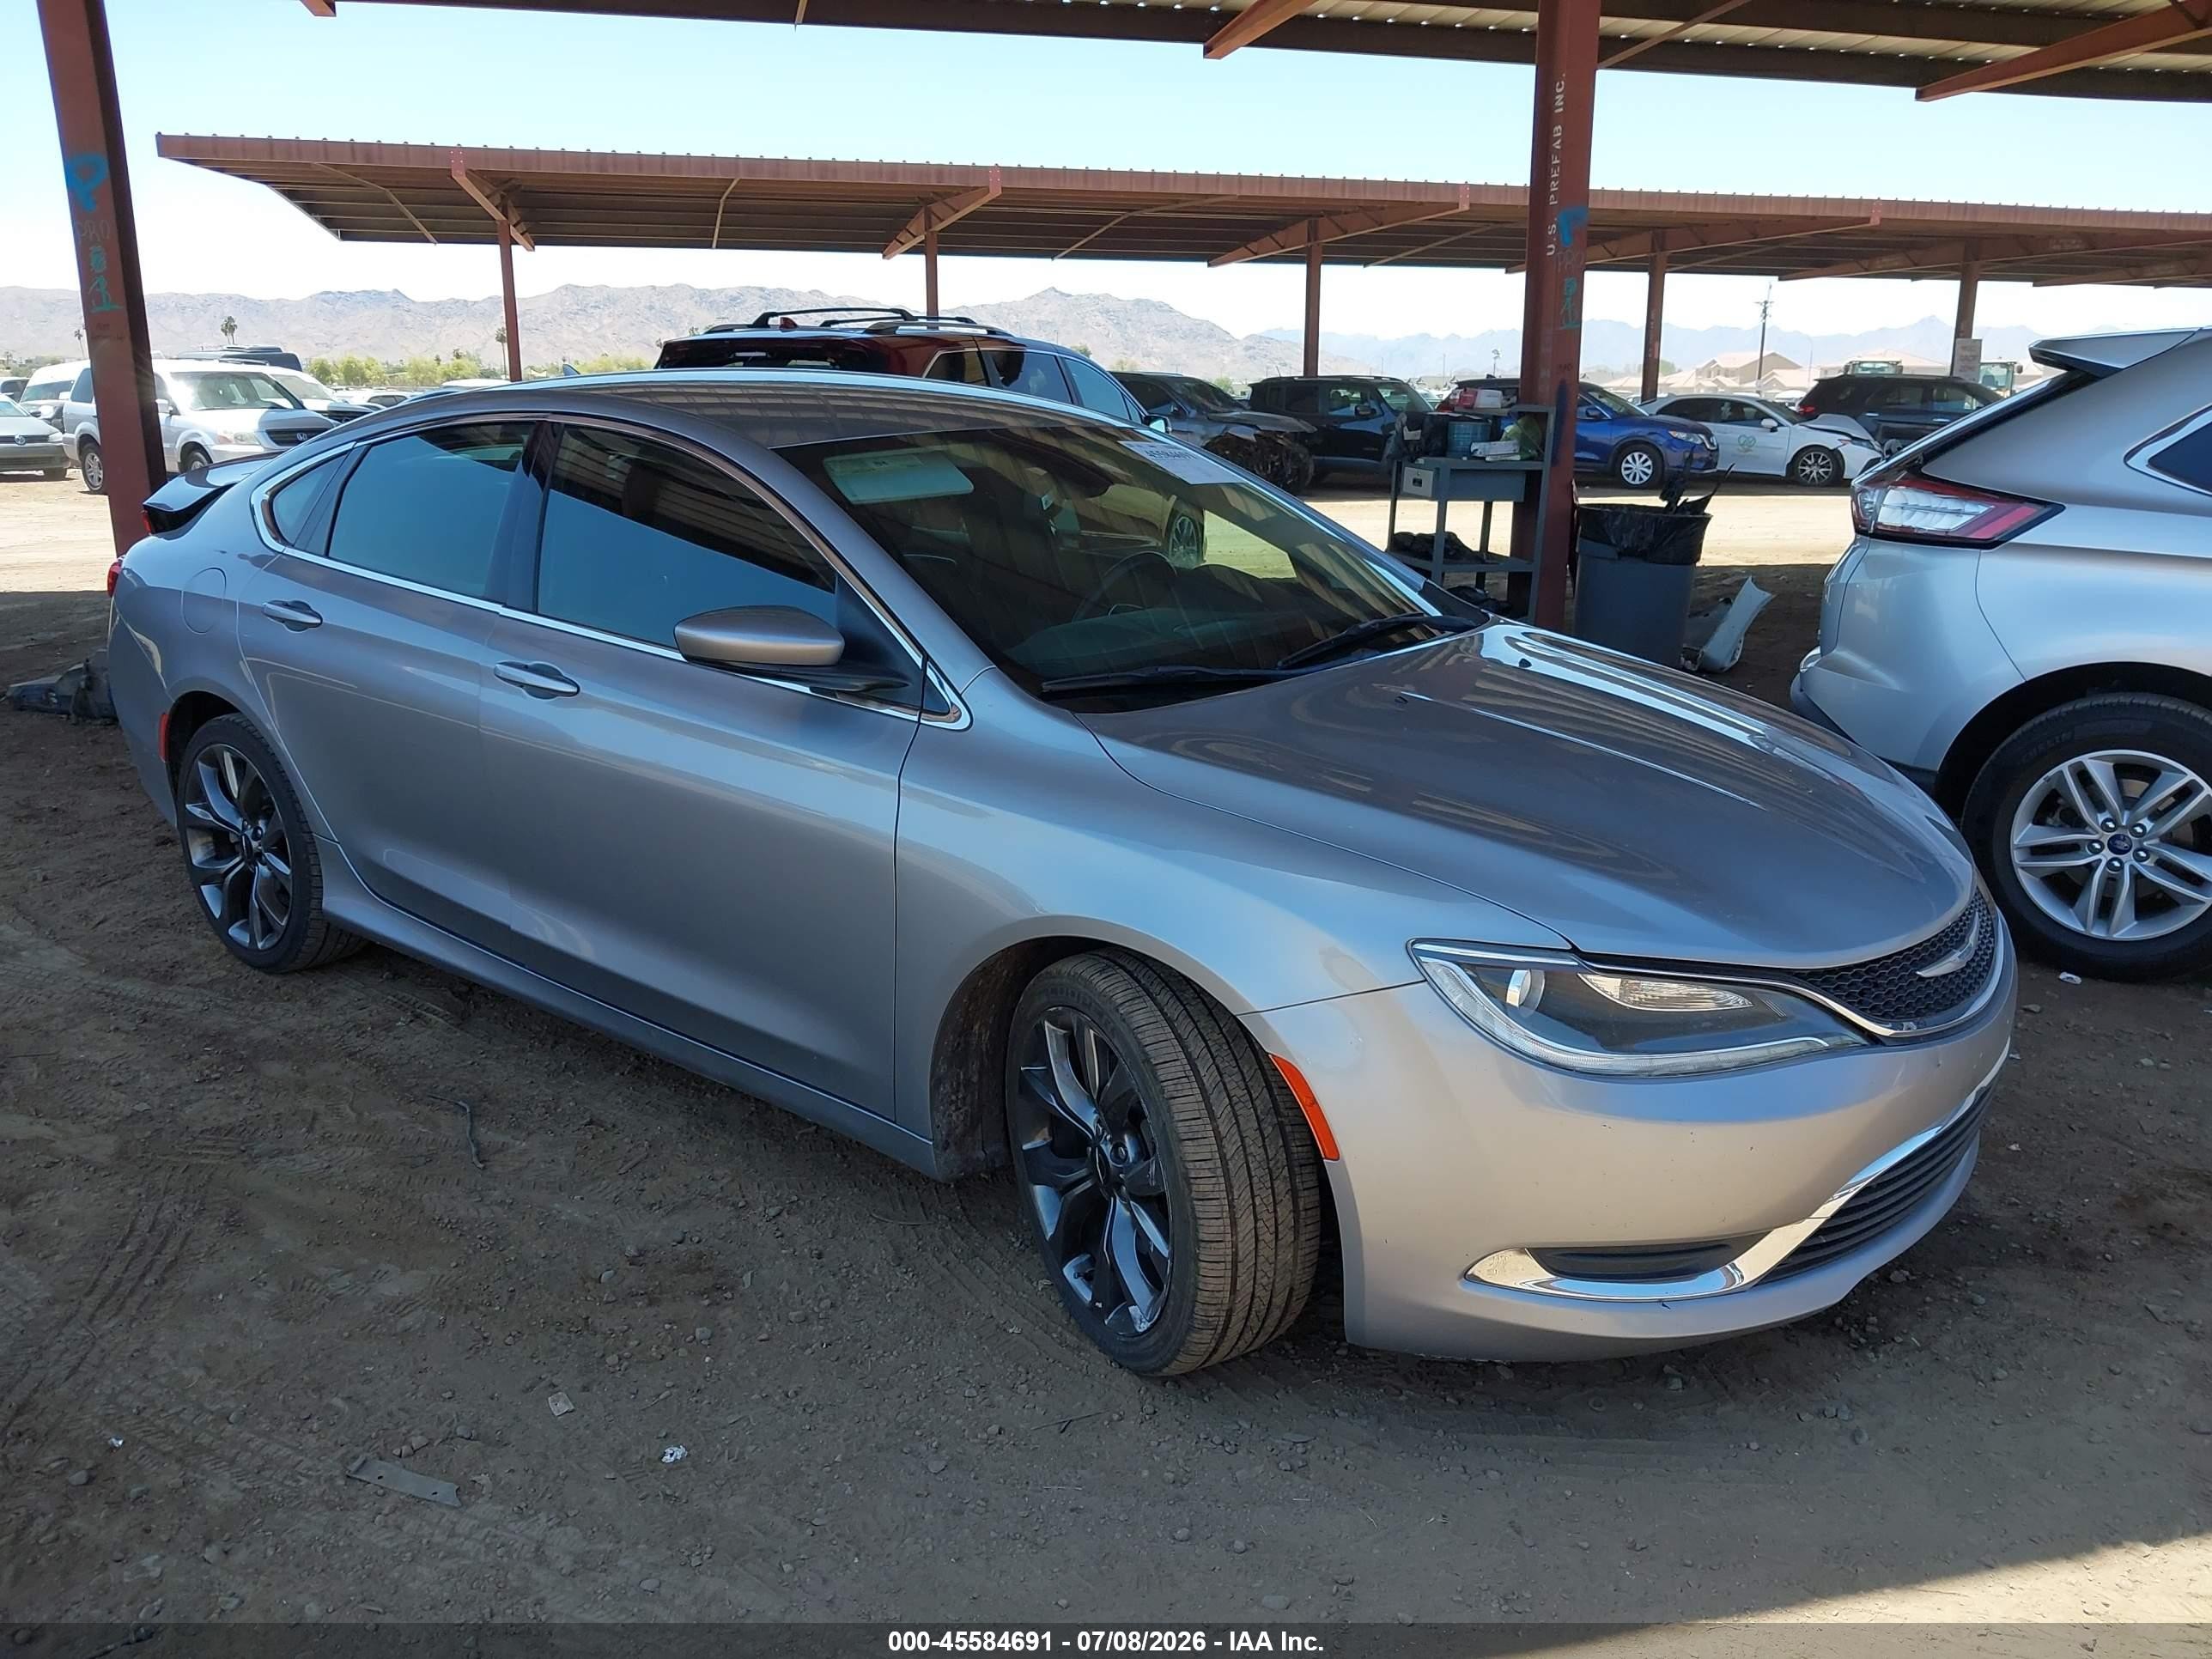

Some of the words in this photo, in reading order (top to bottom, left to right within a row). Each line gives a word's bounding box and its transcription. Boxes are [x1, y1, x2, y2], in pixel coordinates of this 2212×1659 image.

[1554, 72, 1566, 114] INC.
[1548, 124, 1563, 206] PREFAB
[1546, 216, 1558, 257] U.S.
